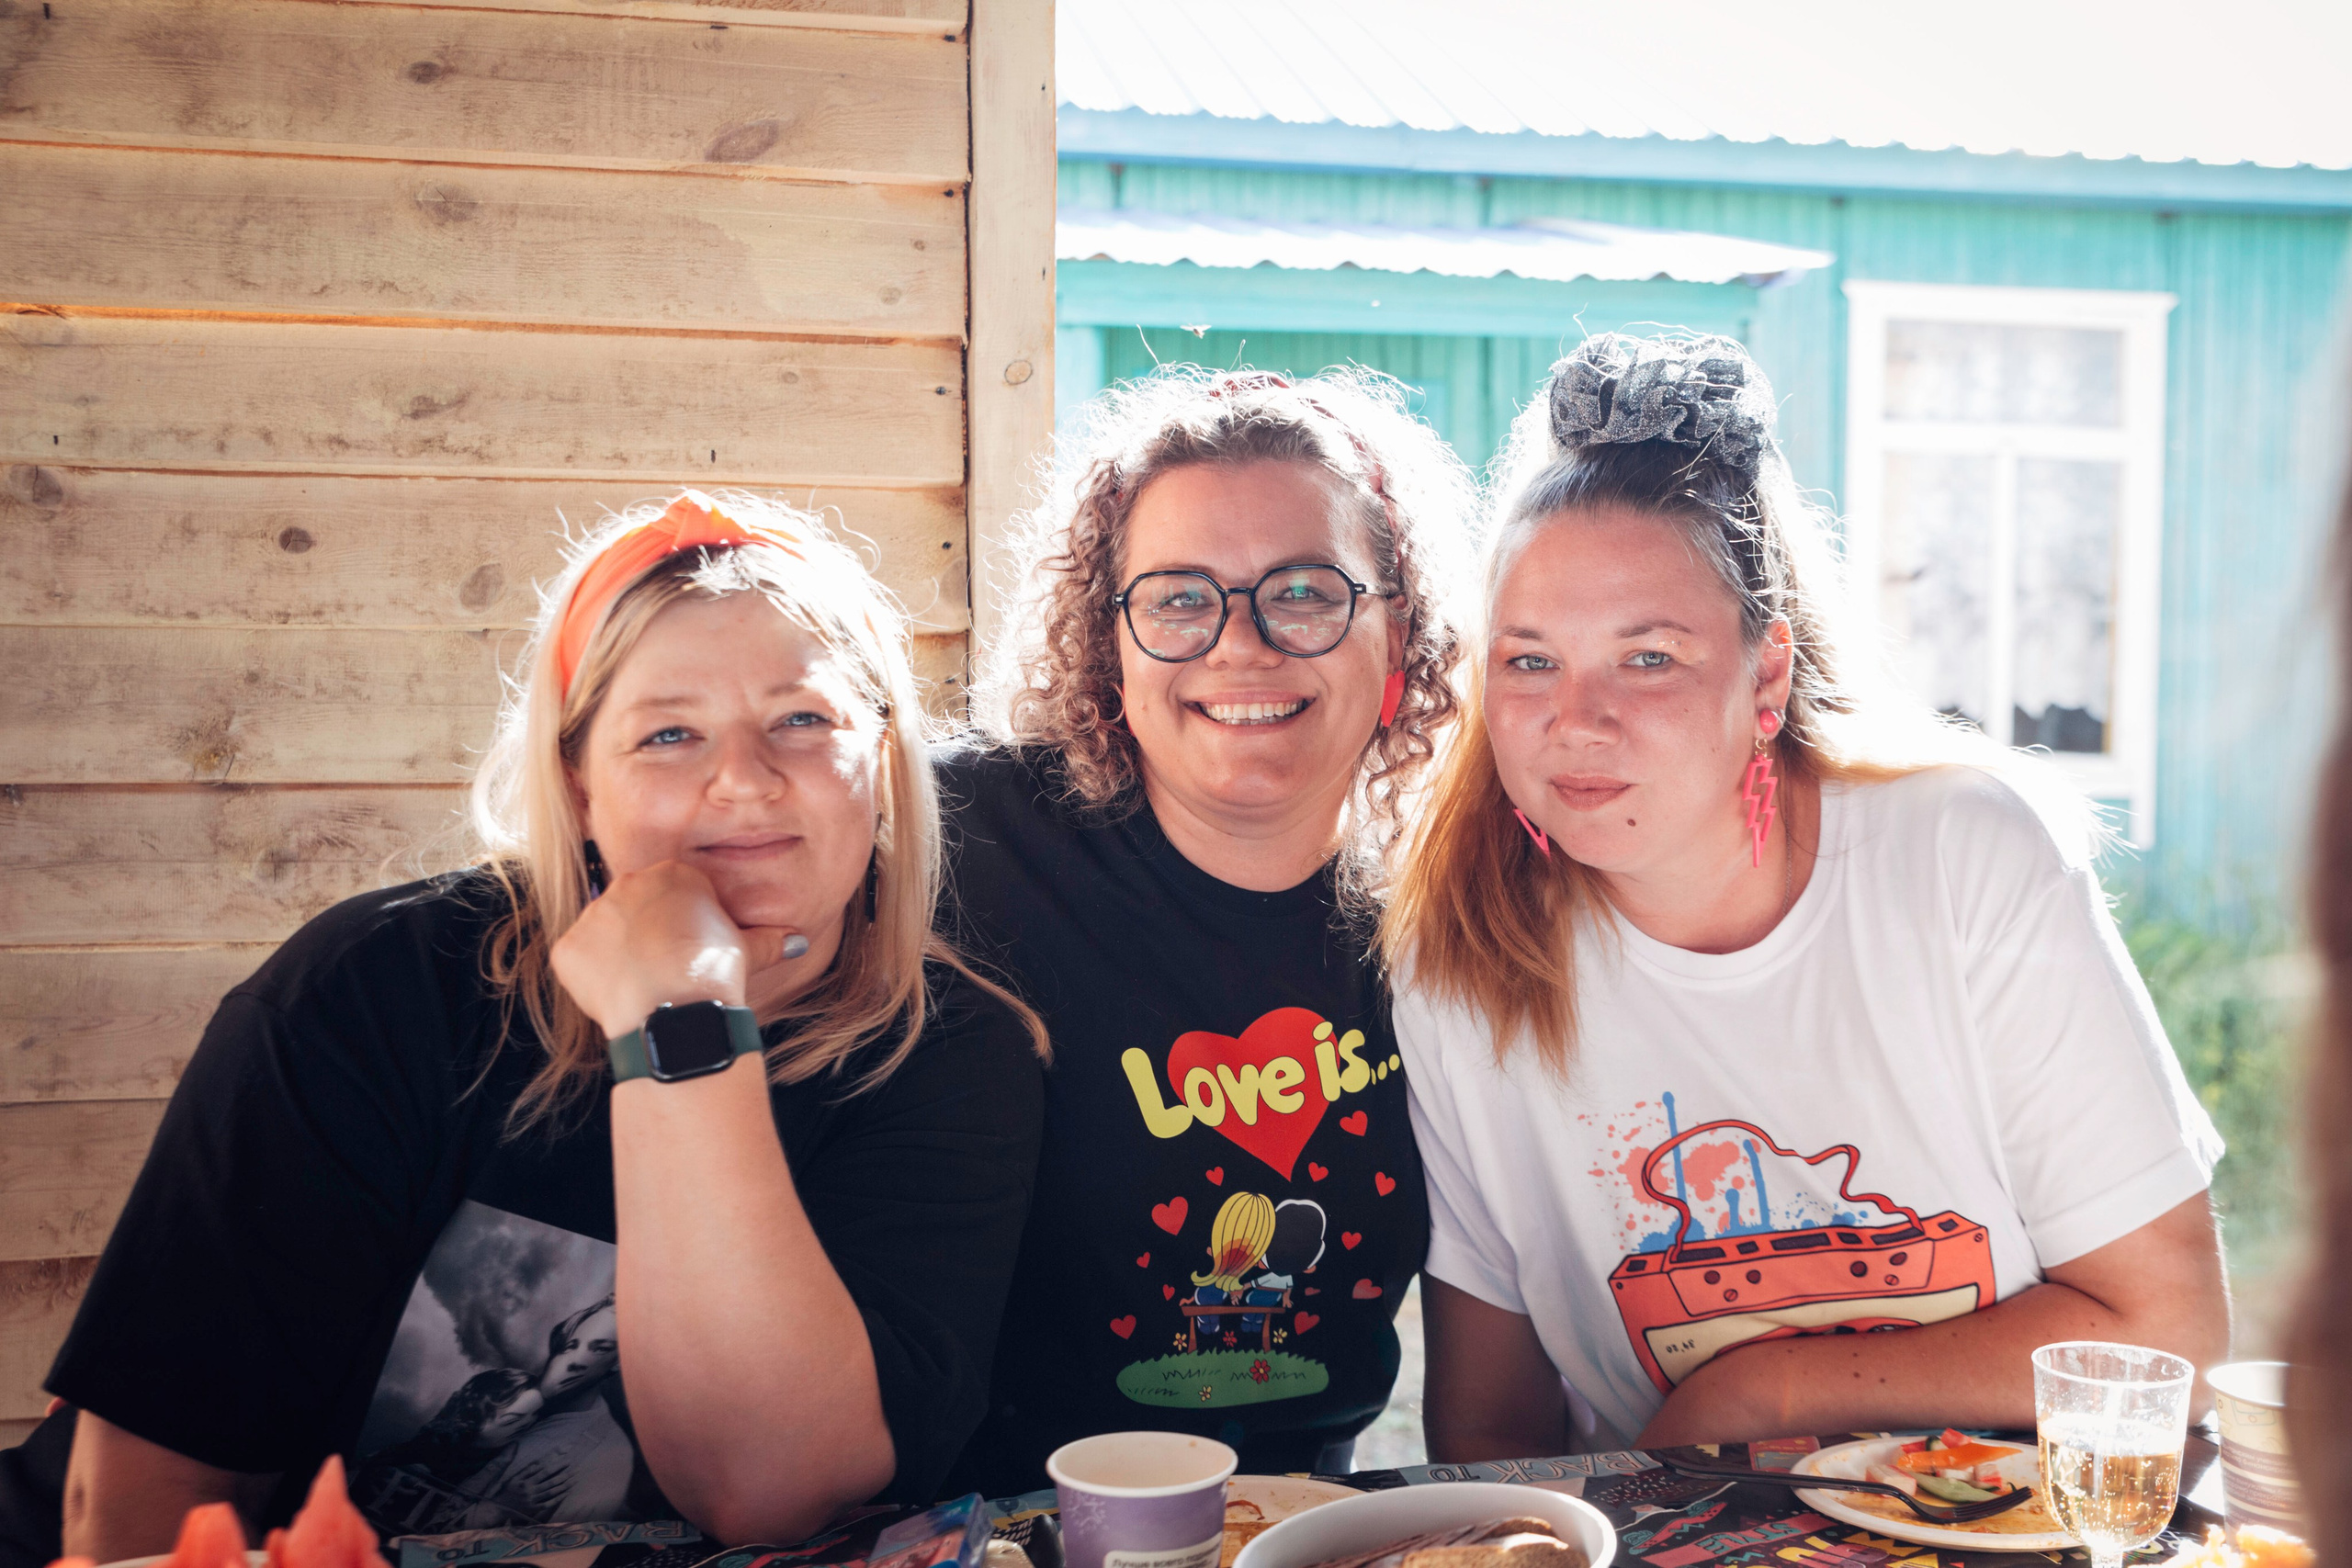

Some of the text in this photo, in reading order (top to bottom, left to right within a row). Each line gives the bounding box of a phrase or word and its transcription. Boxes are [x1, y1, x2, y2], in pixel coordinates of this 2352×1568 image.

[1121, 1047, 1306, 1139] Love
[1427, 1450, 1652, 1483] BACK TO
[435, 1519, 690, 1561] BACK TO
[1695, 1522, 1803, 1554] STYLE
